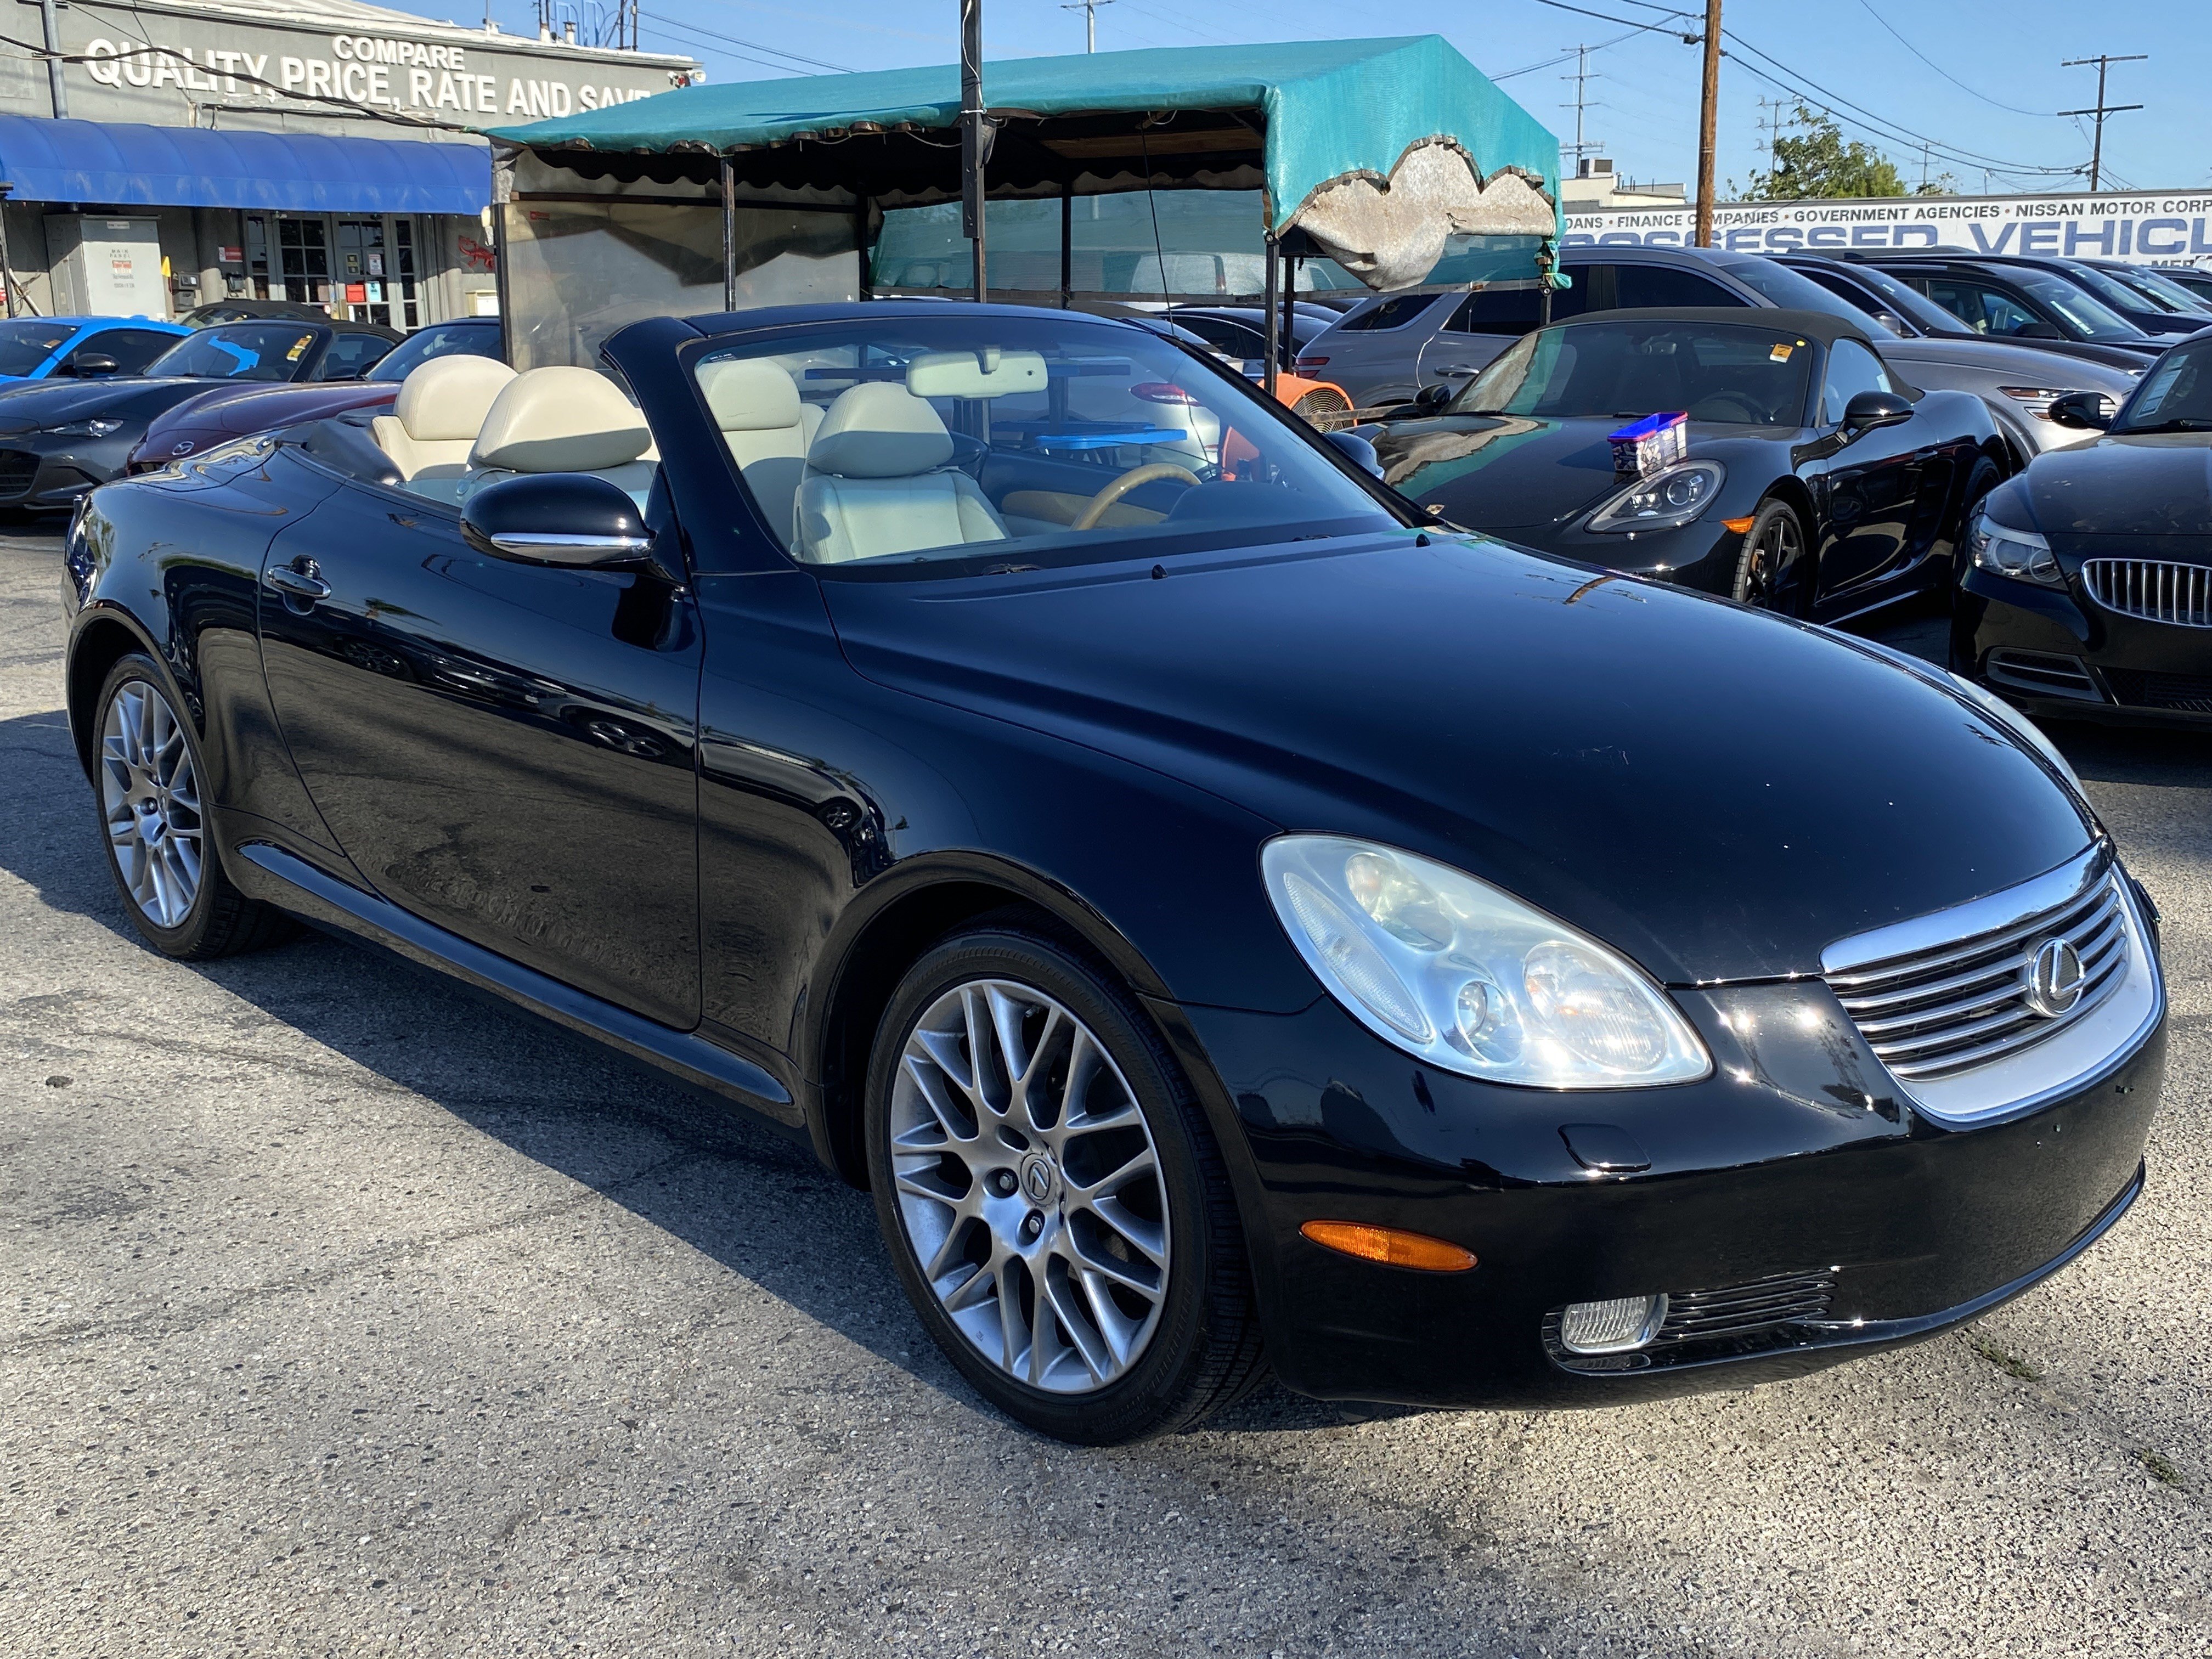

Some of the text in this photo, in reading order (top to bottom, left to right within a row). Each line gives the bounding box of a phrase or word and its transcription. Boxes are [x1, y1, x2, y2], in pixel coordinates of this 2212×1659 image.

[332, 35, 465, 71] COMPARE
[280, 56, 400, 109] PRICE,
[409, 69, 498, 114] RATE
[505, 77, 572, 119] AND
[578, 84, 651, 113] SA
[1617, 215, 1683, 228] FINANCE
[1688, 212, 1779, 225] CMPANIES
[1794, 208, 1909, 222] GOVERNMENT
[1914, 205, 2000, 219] AGENCIES
[2016, 204, 2084, 217] NISSAN
[2090, 201, 2156, 215] MOTOR
